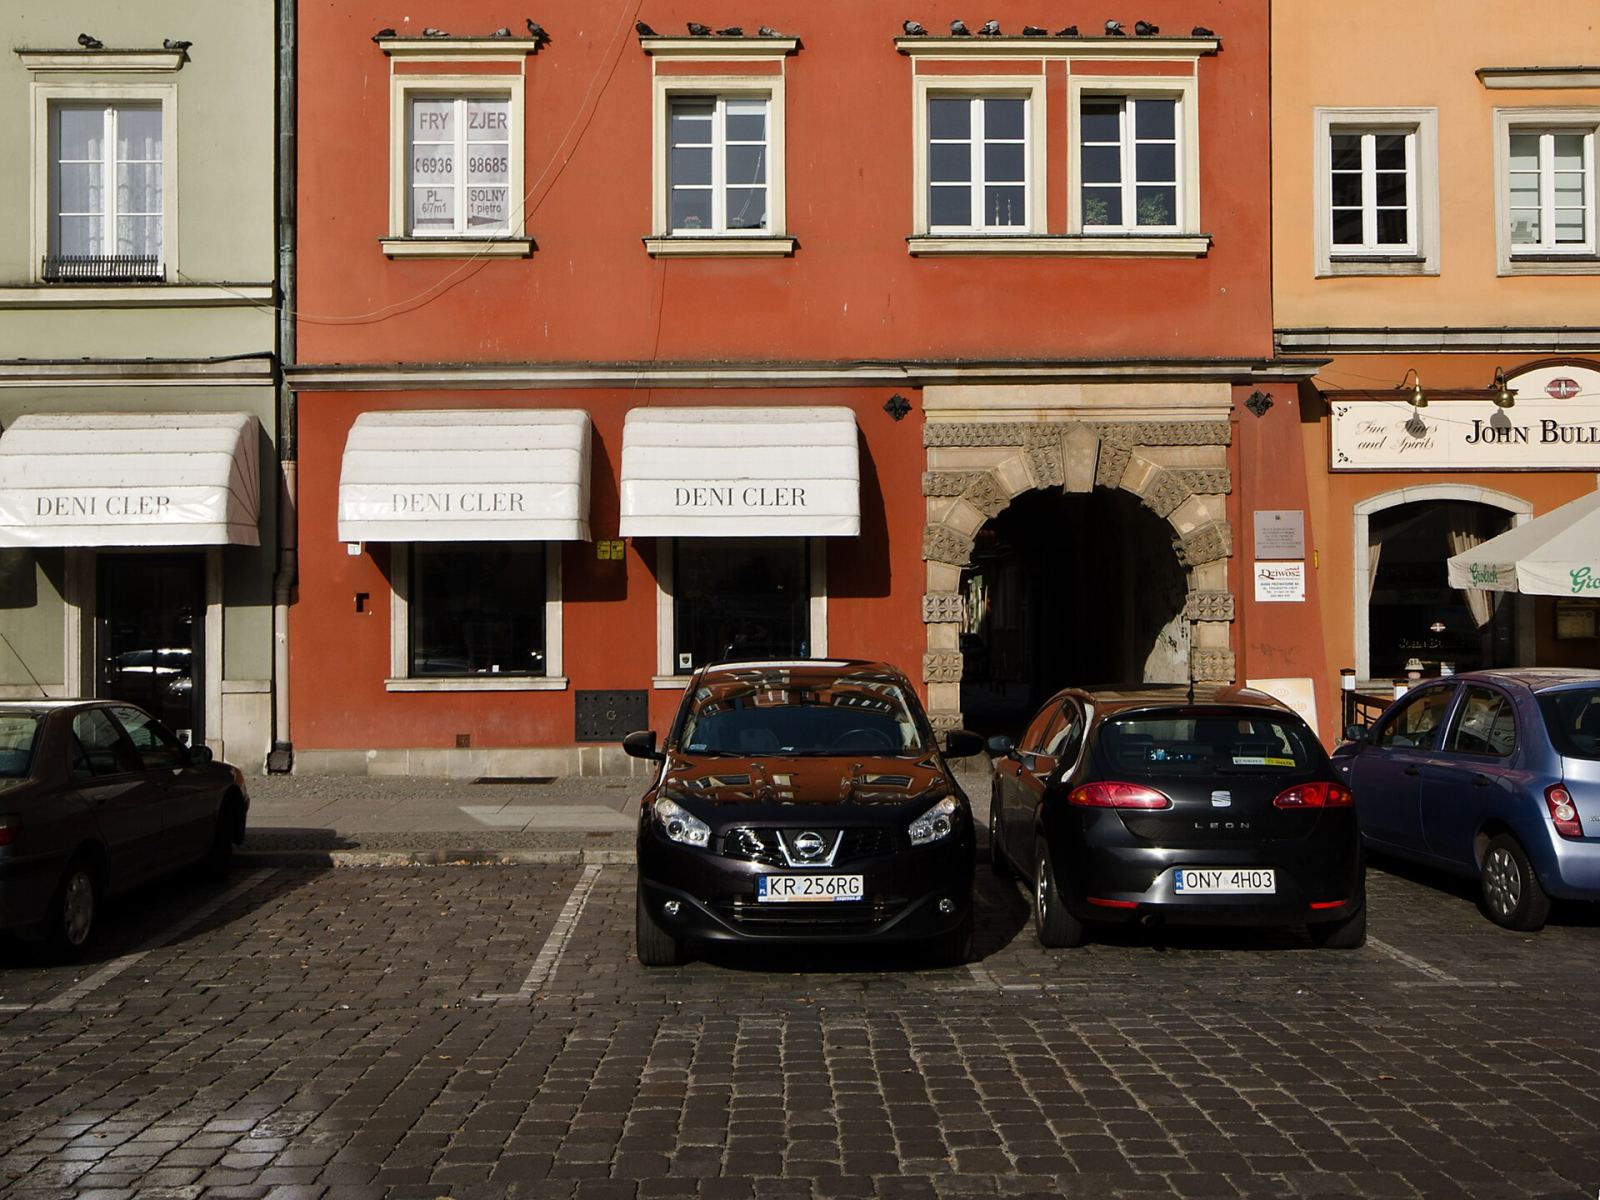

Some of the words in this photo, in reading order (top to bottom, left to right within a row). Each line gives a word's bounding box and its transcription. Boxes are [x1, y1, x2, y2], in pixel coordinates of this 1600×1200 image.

[419, 112, 449, 130] FRY
[469, 112, 508, 130] ZJER
[469, 157, 508, 173] 98685
[426, 190, 443, 203] PL.
[470, 189, 506, 202] SOLNY
[470, 203, 474, 213] 1
[1465, 419, 1529, 445] JOHN
[1357, 435, 1388, 449] and
[1390, 436, 1434, 454] Spirits
[36, 496, 97, 516] DENI
[106, 495, 171, 516] CLER
[392, 492, 452, 512] DENI
[459, 492, 525, 512] CLER
[674, 487, 734, 506] DENI
[742, 487, 807, 506] CLER
[770, 878, 796, 895] KR
[803, 877, 859, 895] 256RG
[1186, 872, 1222, 888] ONY
